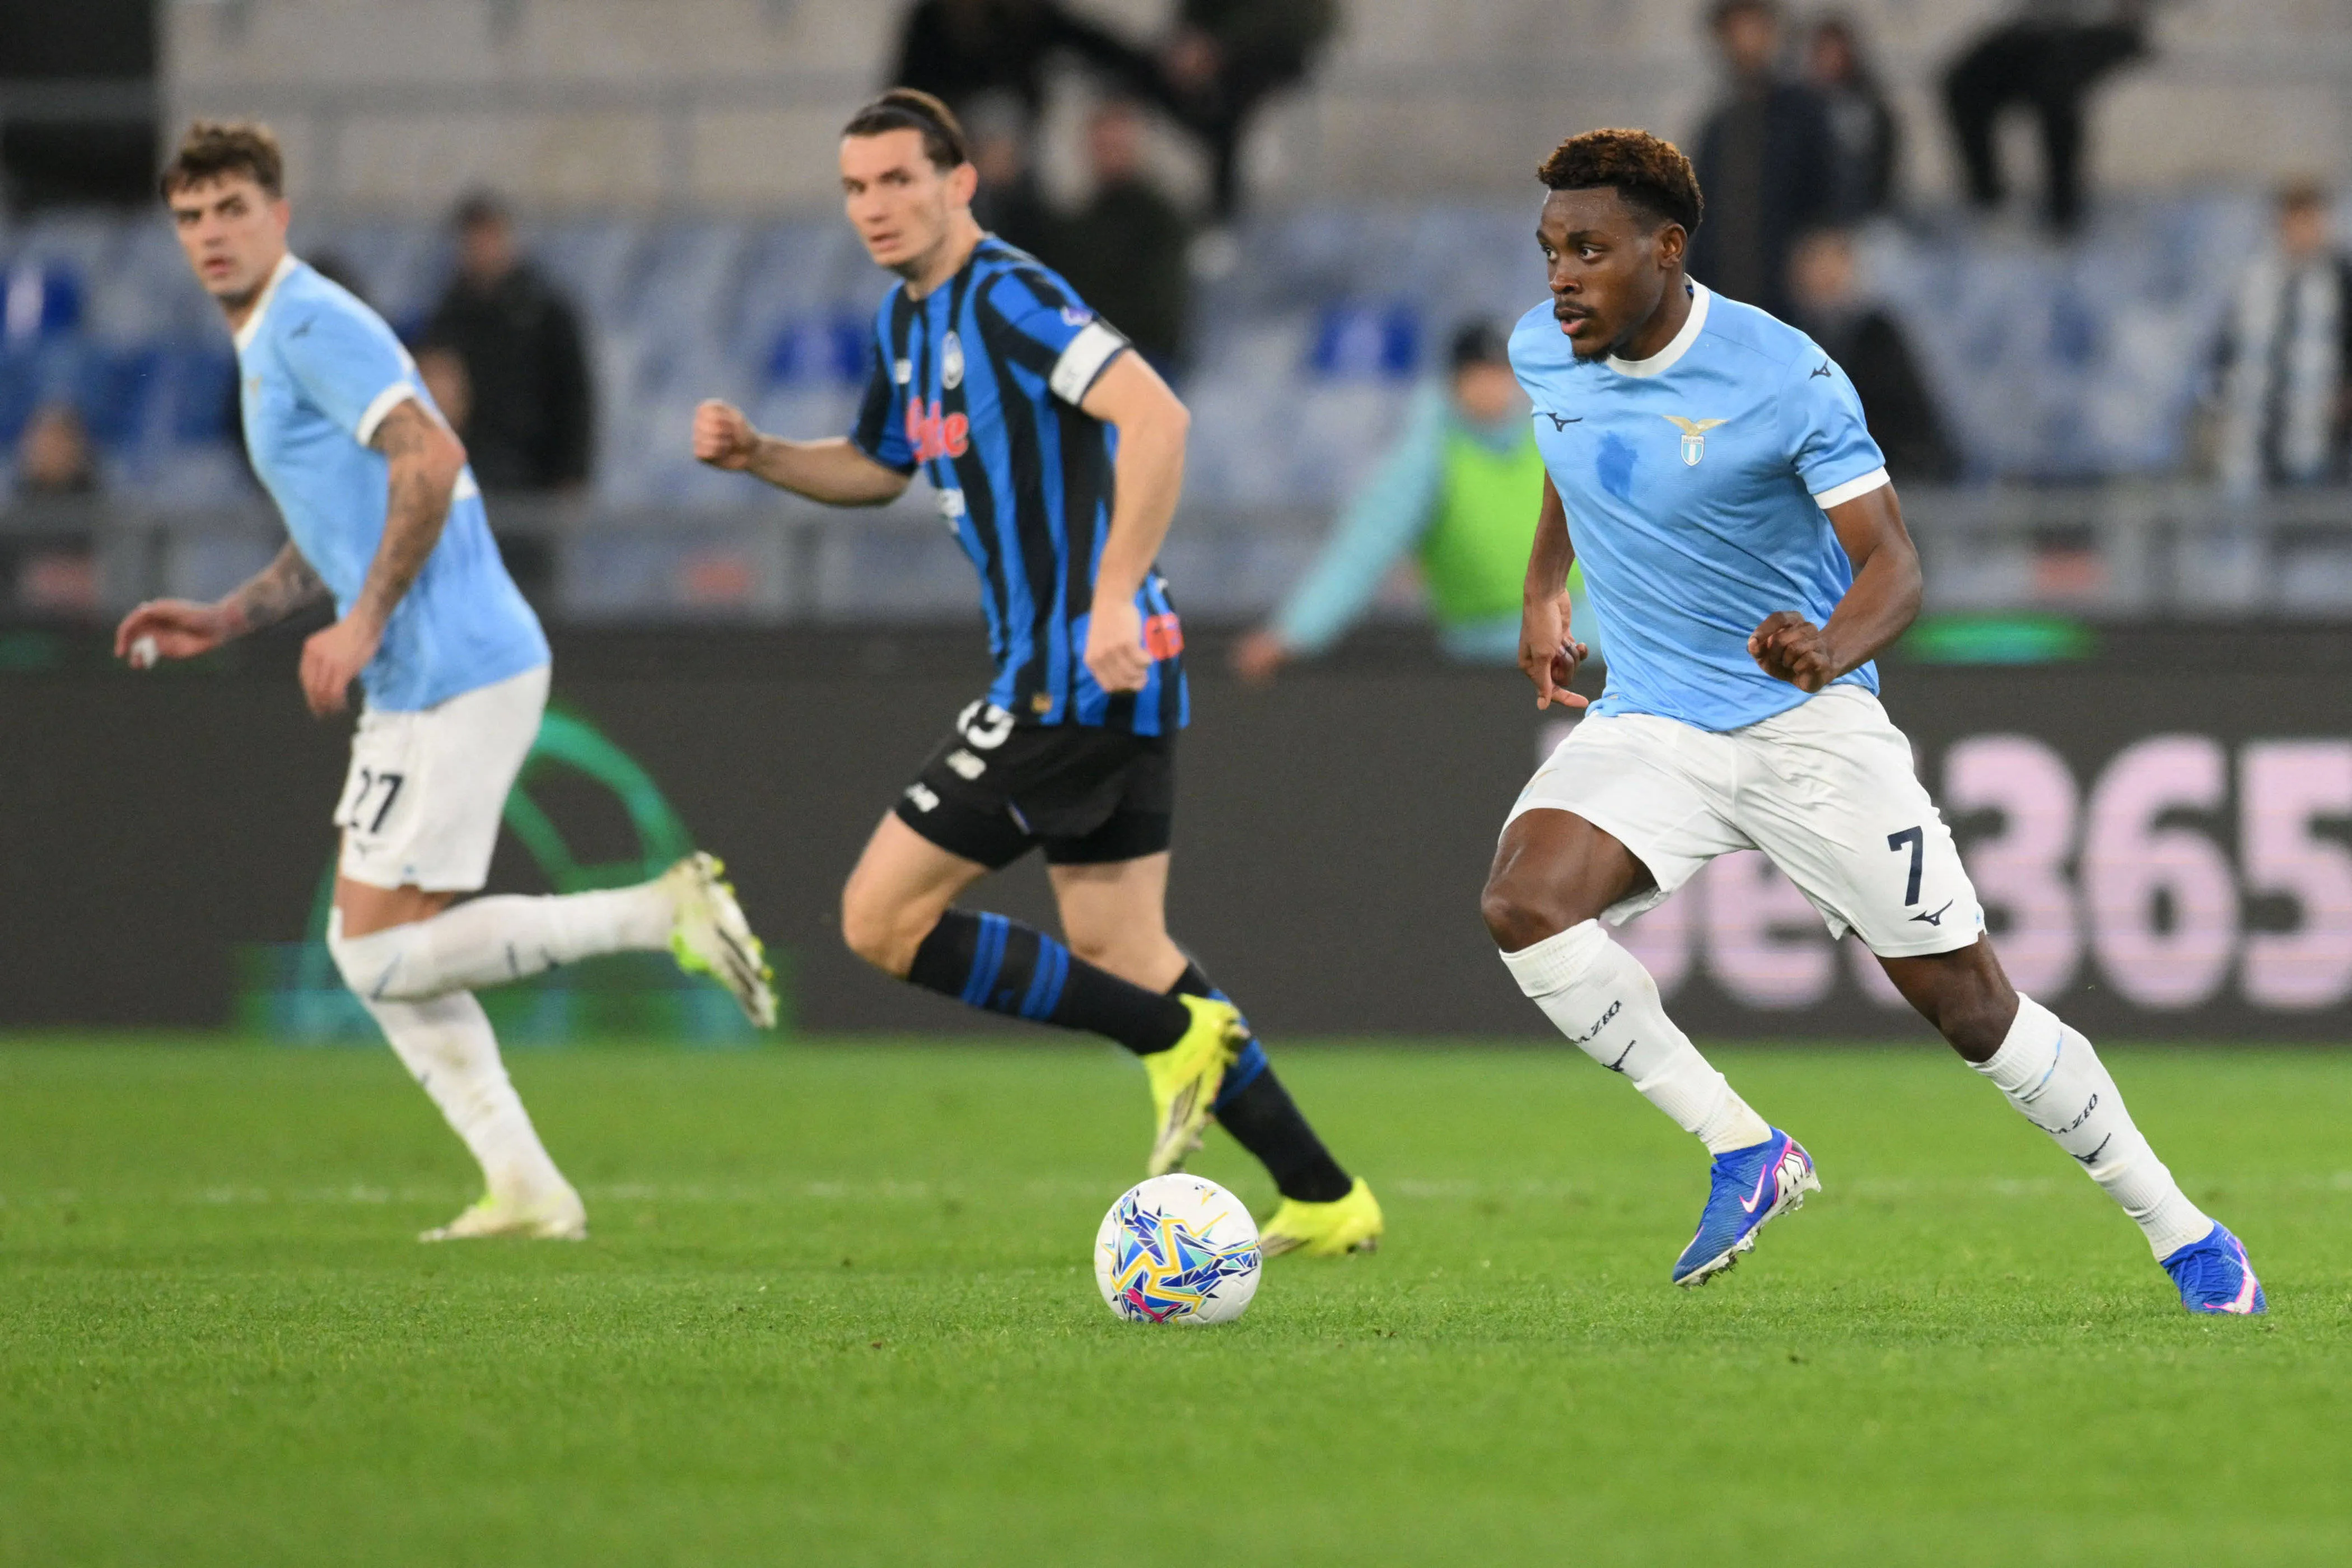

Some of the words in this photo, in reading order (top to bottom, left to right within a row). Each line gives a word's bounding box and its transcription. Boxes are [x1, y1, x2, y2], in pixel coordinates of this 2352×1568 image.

[351, 767, 404, 833] 27
[1537, 720, 2352, 1009] e365
[1887, 825, 1923, 906] 7
[1570, 1000, 1622, 1044] AZIO
[2045, 1093, 2098, 1135] AZIO
